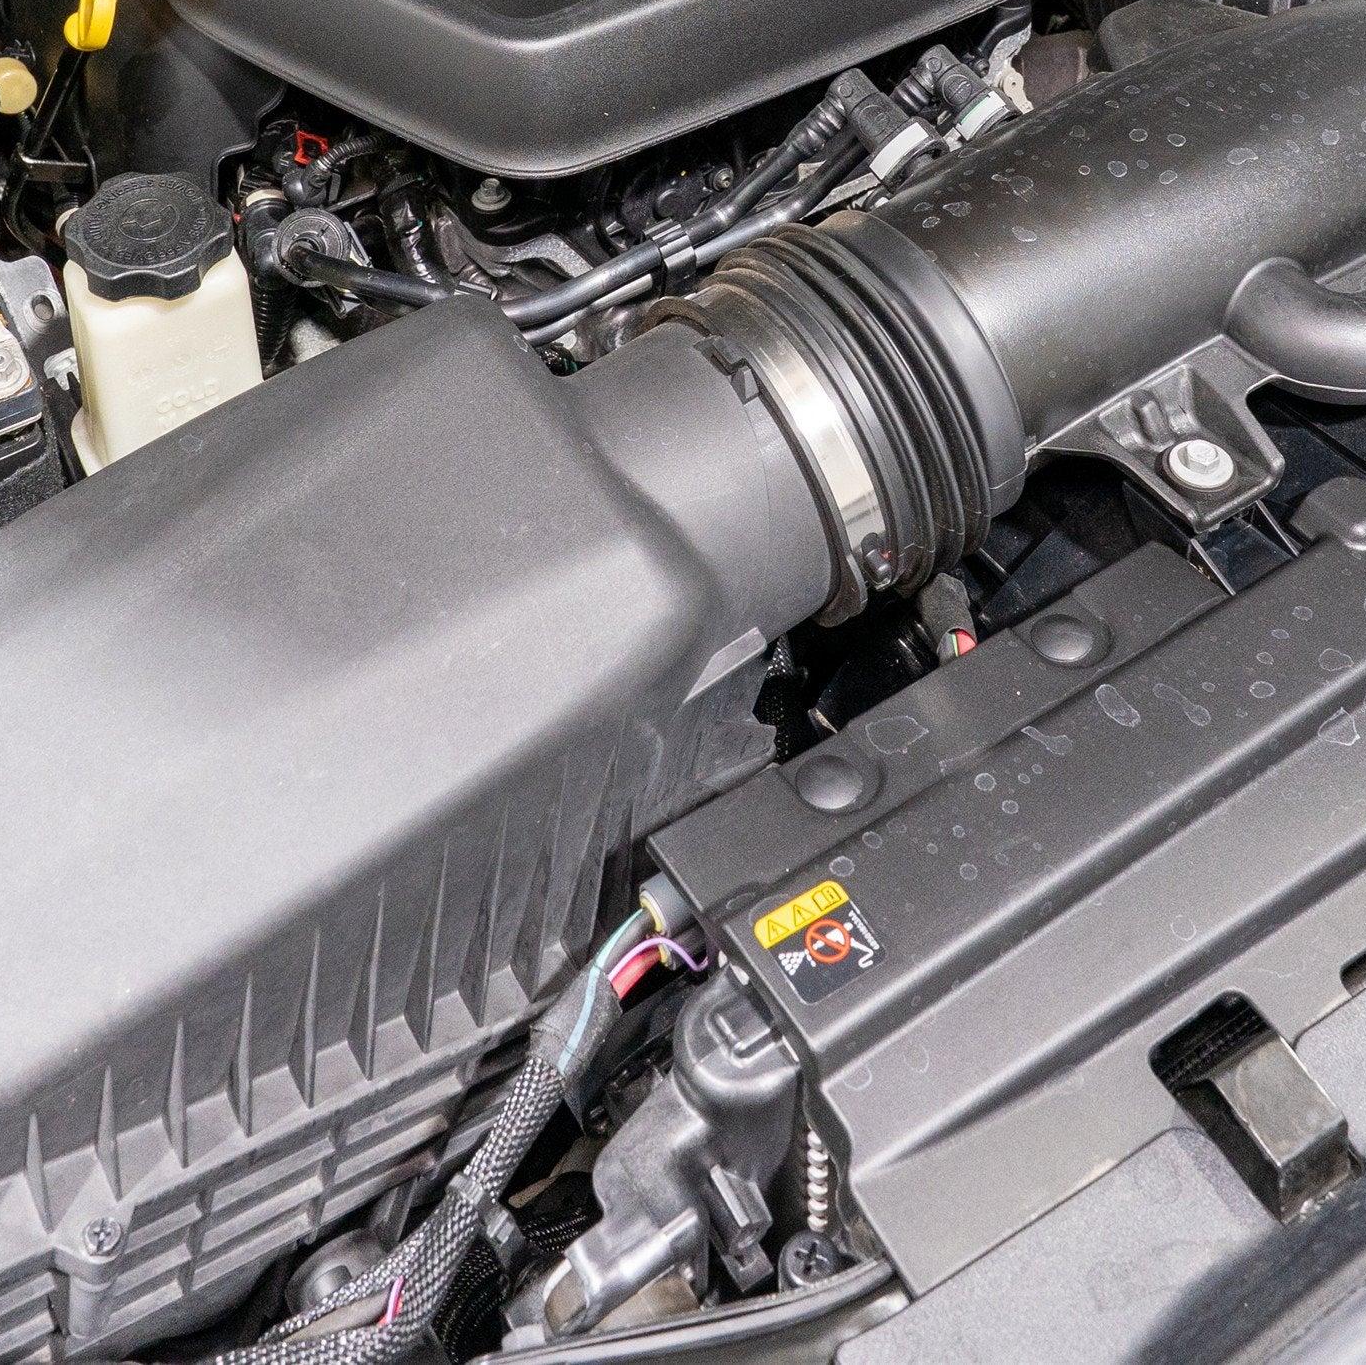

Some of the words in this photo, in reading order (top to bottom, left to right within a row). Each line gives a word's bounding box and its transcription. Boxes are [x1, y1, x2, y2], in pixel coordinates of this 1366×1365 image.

[95, 178, 154, 212] STEERING
[157, 179, 203, 203] POWER
[155, 377, 221, 414] COLD
